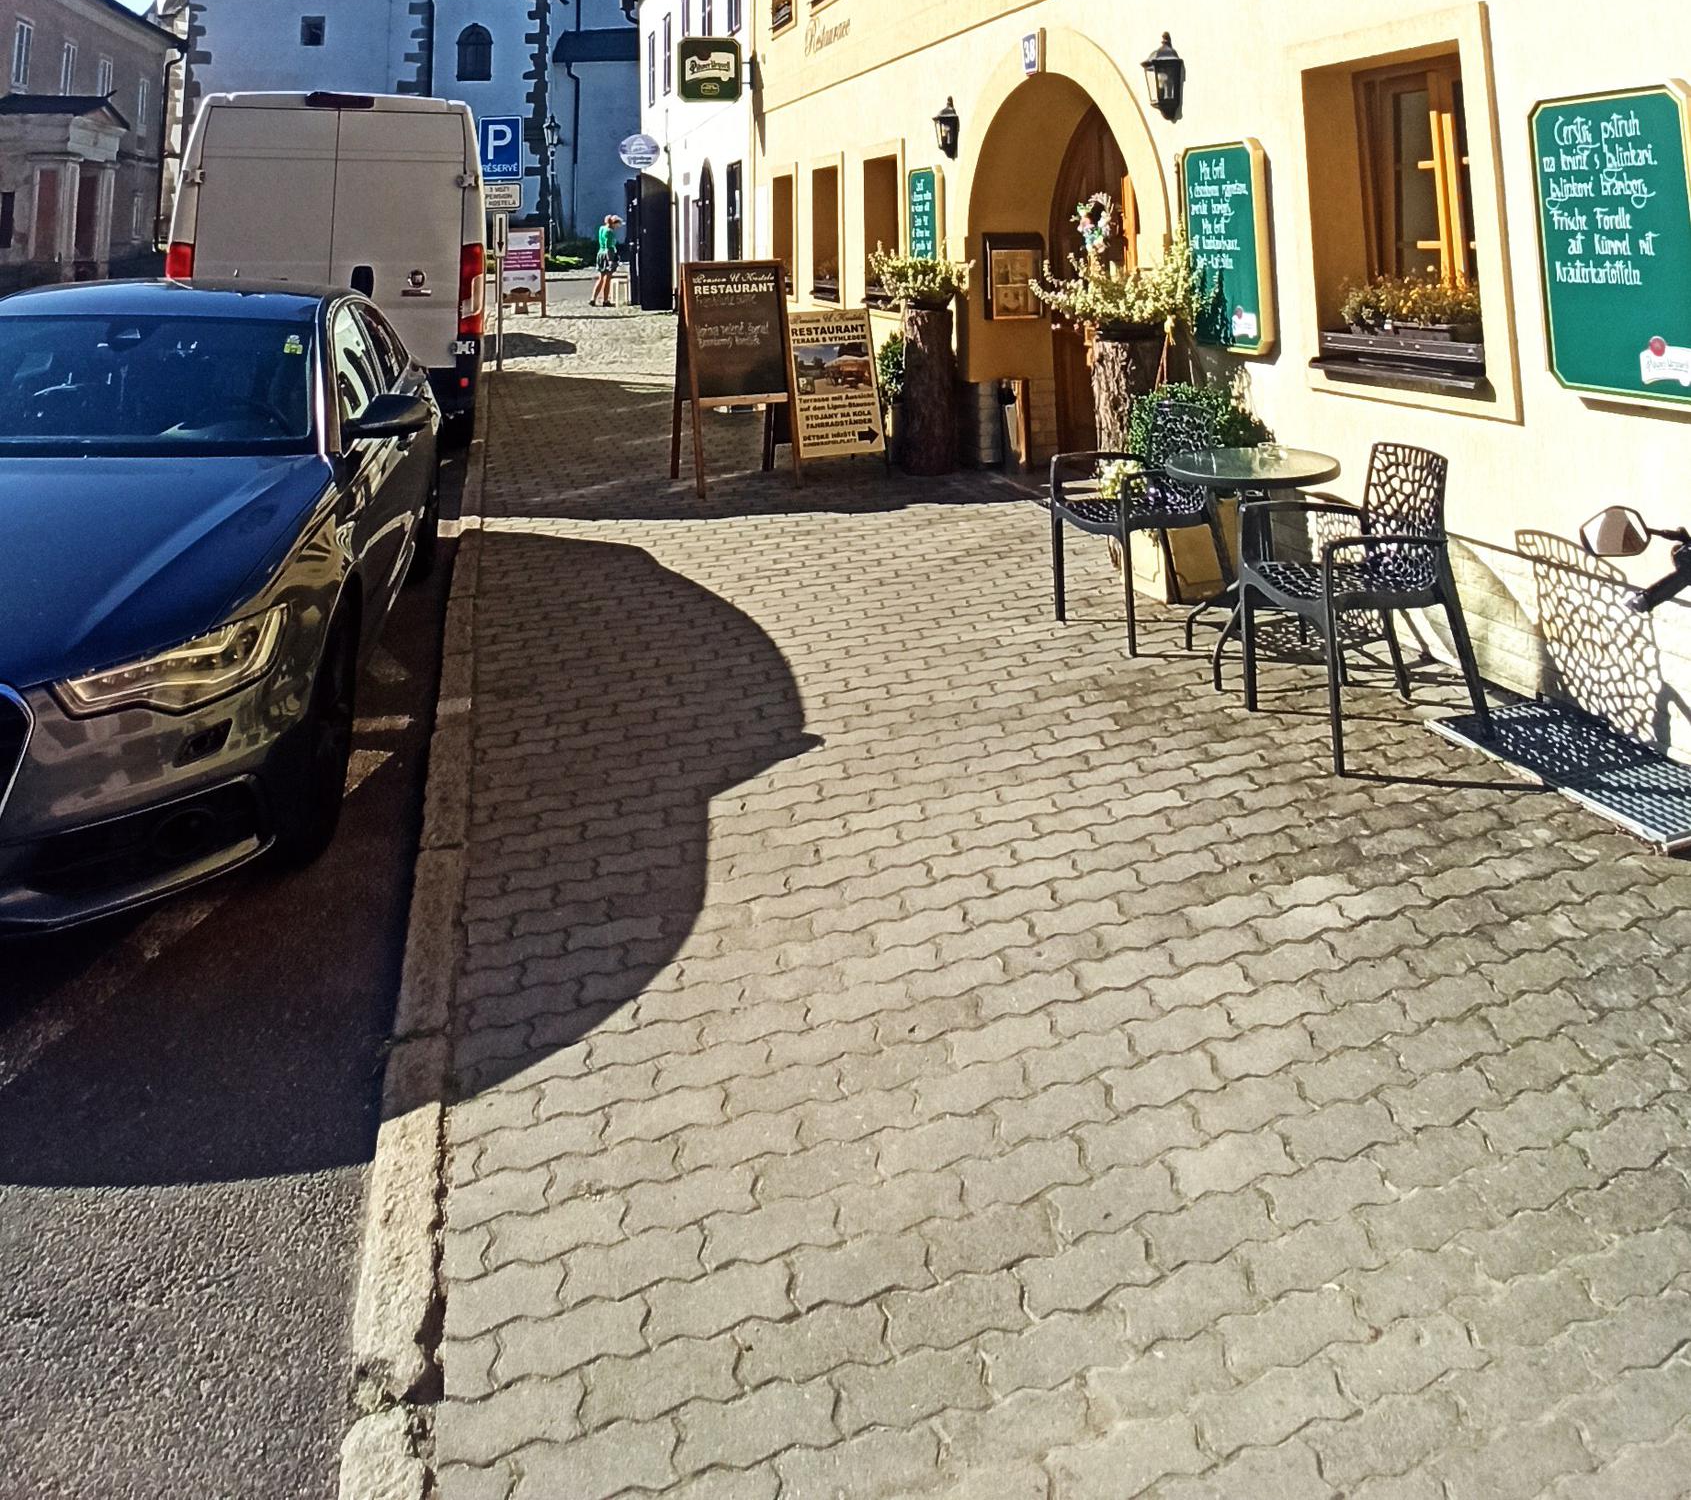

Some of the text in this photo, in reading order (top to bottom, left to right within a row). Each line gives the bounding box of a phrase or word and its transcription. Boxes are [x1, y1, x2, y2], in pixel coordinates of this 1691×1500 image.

[1023, 38, 1036, 64] 38
[1600, 110, 1640, 152] pstruh
[488, 125, 512, 160] P
[482, 162, 518, 173] RÉSERVÉ
[1199, 157, 1225, 181] Mix Grill
[1543, 156, 1556, 172] na
[1550, 207, 1632, 230] Frische Forelle
[1201, 217, 1225, 235] Mix Grill
[692, 274, 726, 283] Pension
[694, 283, 775, 295] RESTAURANT
[791, 324, 865, 337] RESTAURANT
[792, 337, 820, 345] TERASA
[799, 392, 875, 404] Terrasse mit Aussicht
[800, 404, 811, 412] auf
[812, 403, 826, 411] den
[805, 410, 872, 421] STOJANY NA KOLA
